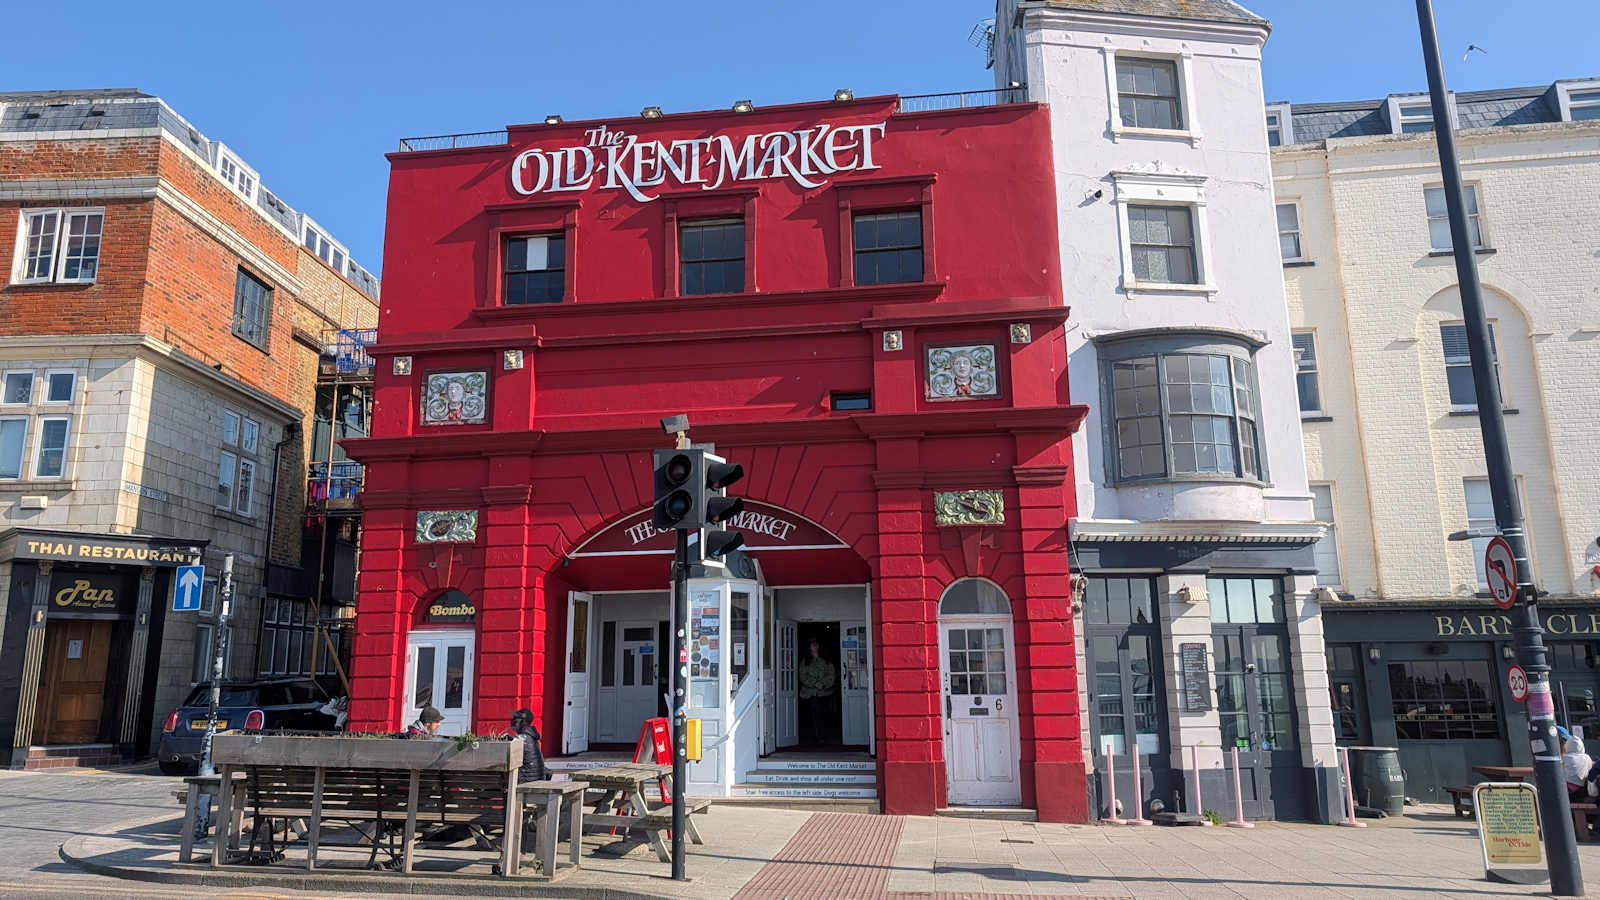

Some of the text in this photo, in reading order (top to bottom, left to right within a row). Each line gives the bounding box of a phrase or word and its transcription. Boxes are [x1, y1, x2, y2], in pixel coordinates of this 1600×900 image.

[584, 124, 625, 148] The
[511, 121, 886, 203] OLD KENT MARKET
[624, 510, 796, 545] THE MARKET
[27, 541, 192, 563] THAI RESTAURANT
[55, 579, 114, 607] Pan
[429, 603, 476, 616] Bombo
[1435, 614, 1600, 636] BARNCLE
[1511, 675, 1525, 690] 20
[995, 698, 1003, 711] 6
